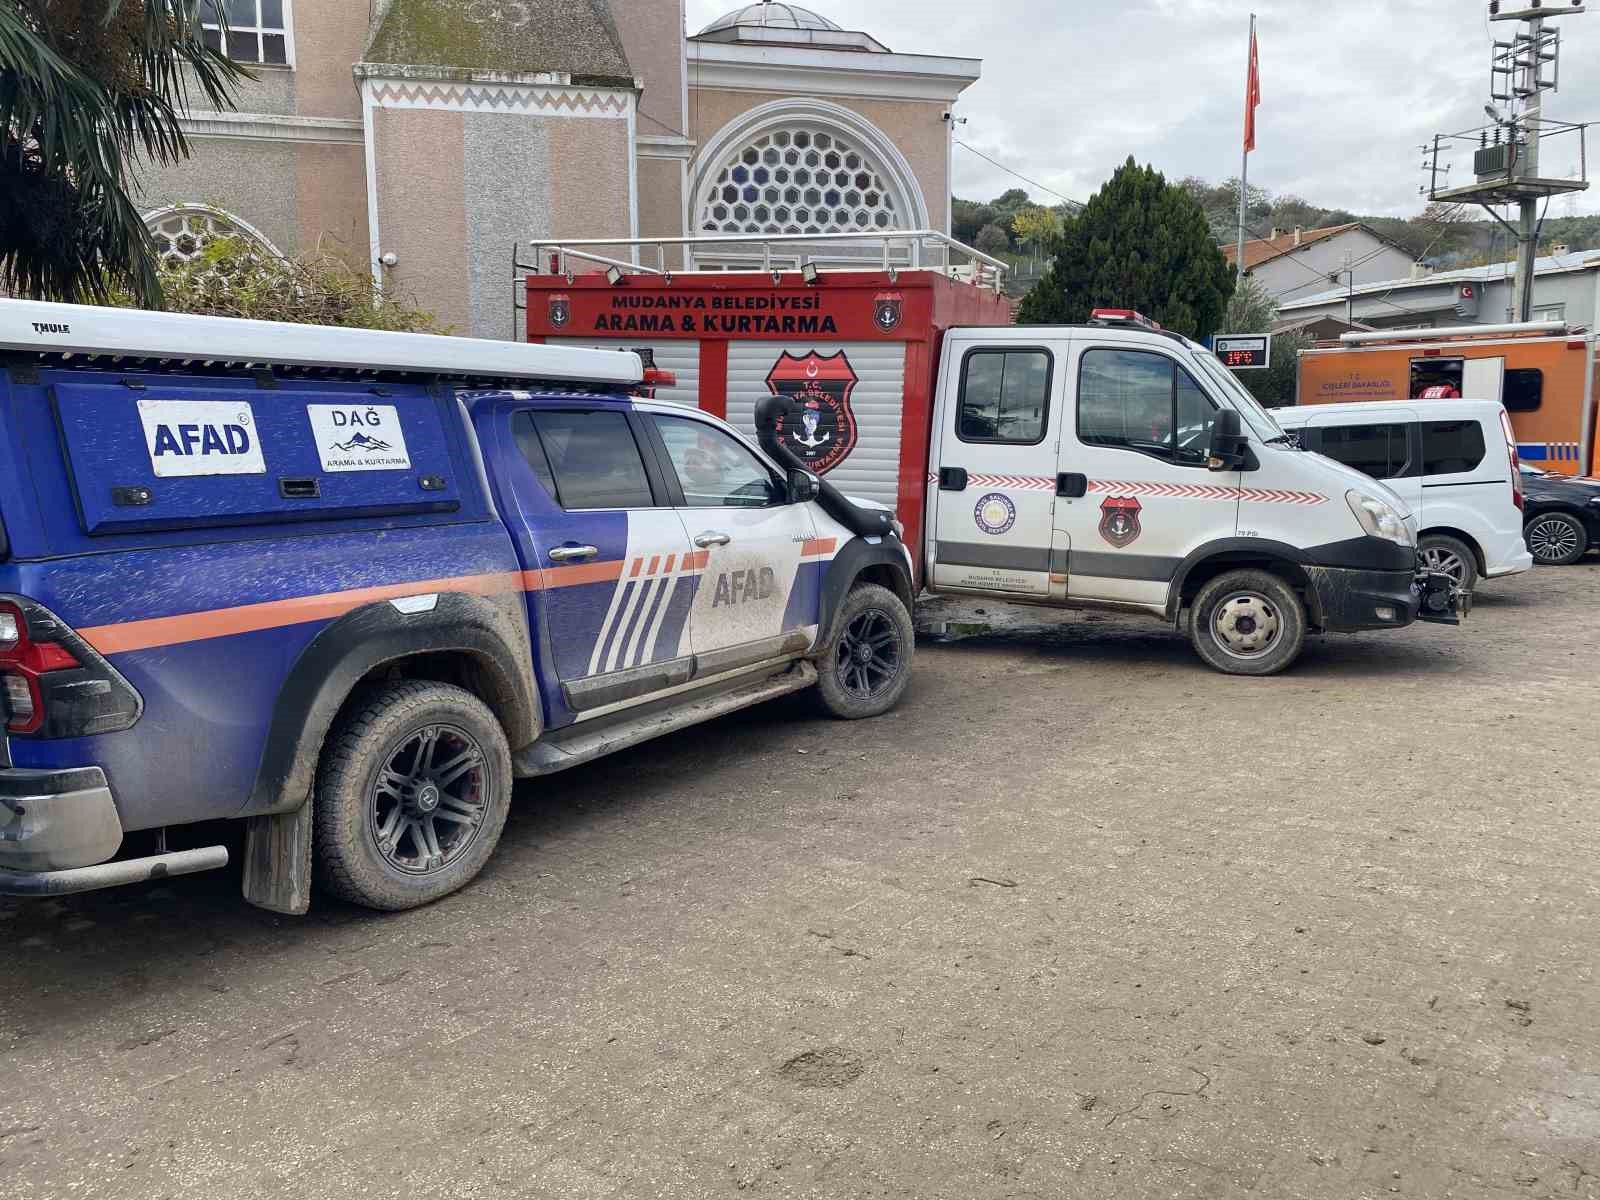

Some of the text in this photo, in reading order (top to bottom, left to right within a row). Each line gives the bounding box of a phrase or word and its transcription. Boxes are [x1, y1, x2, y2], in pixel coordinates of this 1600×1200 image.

[611, 293, 820, 310] MUDANYA BELEDİYESİ
[31, 322, 71, 334] THULE
[593, 314, 838, 333] ARAMA & KURTARMA
[331, 407, 381, 427] DAĞ
[153, 424, 250, 456] AFAD
[327, 458, 356, 466] ARAMA
[364, 457, 407, 465] KURTARMA
[712, 566, 775, 608] AFAD
